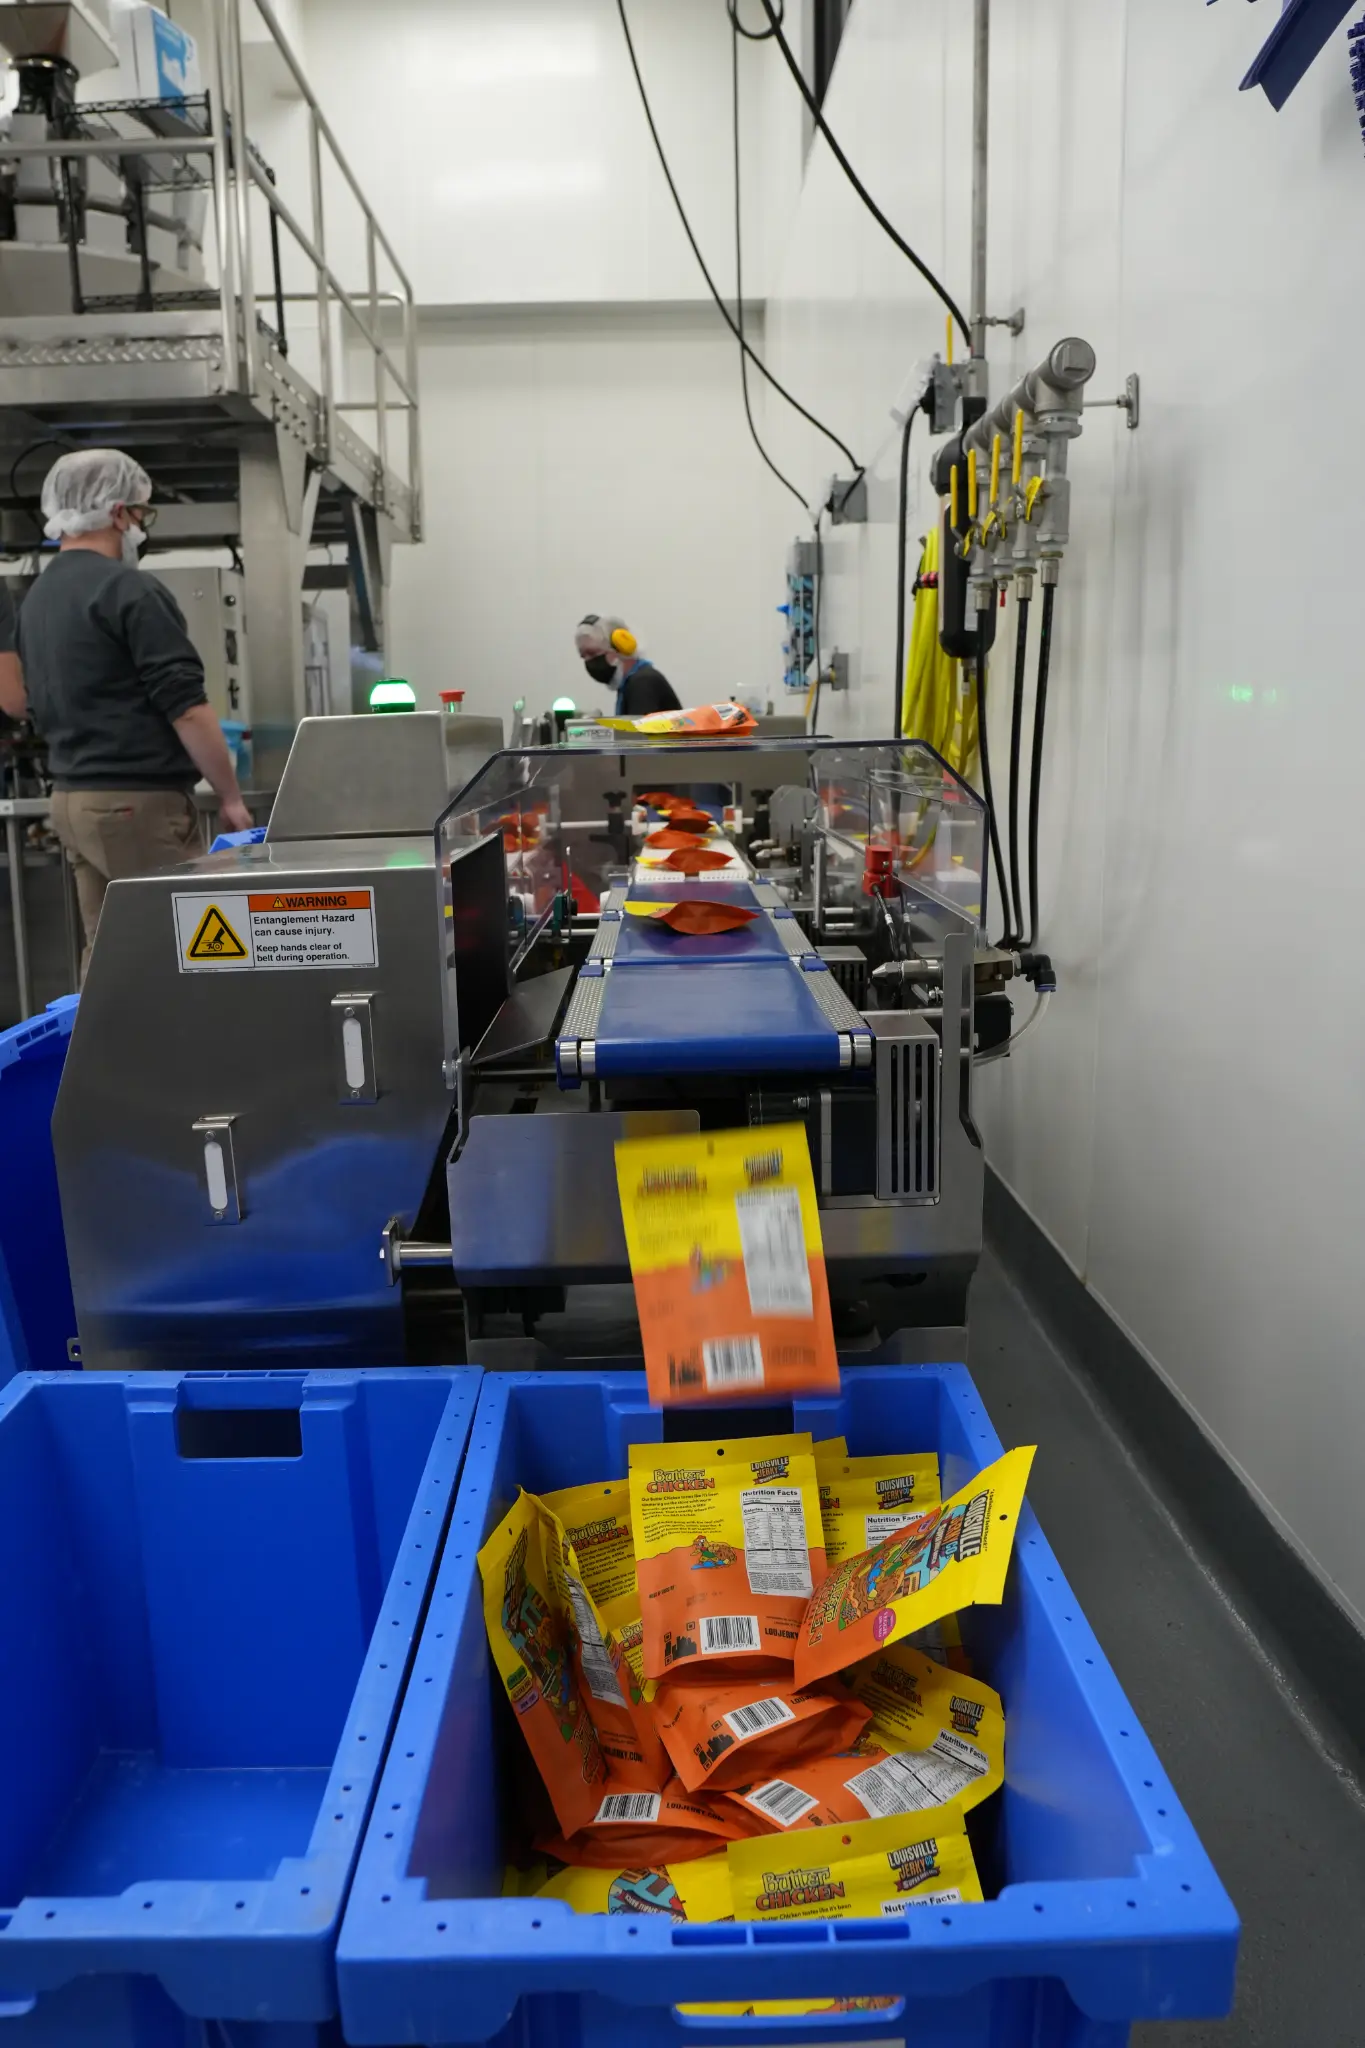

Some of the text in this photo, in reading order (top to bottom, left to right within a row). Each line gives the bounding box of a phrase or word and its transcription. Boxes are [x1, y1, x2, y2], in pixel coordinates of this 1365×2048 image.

[286, 895, 347, 908] WARNING
[254, 914, 355, 925] Entanglement Hazard
[274, 927, 302, 936] cause
[305, 927, 335, 936] injury.
[256, 945, 278, 953] Keep
[280, 944, 308, 952] hands
[333, 942, 342, 950] of
[257, 952, 350, 962] belt during operation.
[751, 1456, 789, 1472] LOUISVILLE
[653, 1469, 705, 1481] Butter
[757, 1467, 778, 1478] JERKY
[646, 1478, 715, 1493] CHICKEN
[875, 1475, 914, 1495] LOUISVILLE
[882, 1489, 903, 1502] JERKY
[867, 1514, 923, 1524] Nutrition Facts
[955, 1489, 989, 1562] LOUISVILLE
[565, 1516, 616, 1541] Butter
[570, 1525, 629, 1552] HICKEN
[950, 1696, 984, 1720] LOUISVILLE
[940, 1731, 987, 1762] Nutrition Facts
[666, 1802, 724, 1822] LOUJERKY.COM
[887, 1837, 938, 1870] LOUISVILLE
[899, 1855, 933, 1880] JERKY CO
[762, 1867, 830, 1894] Butter
[755, 1881, 845, 1910] CHICKEN
[929, 1894, 956, 1904] Facts
[779, 1911, 801, 1920] Chicken
